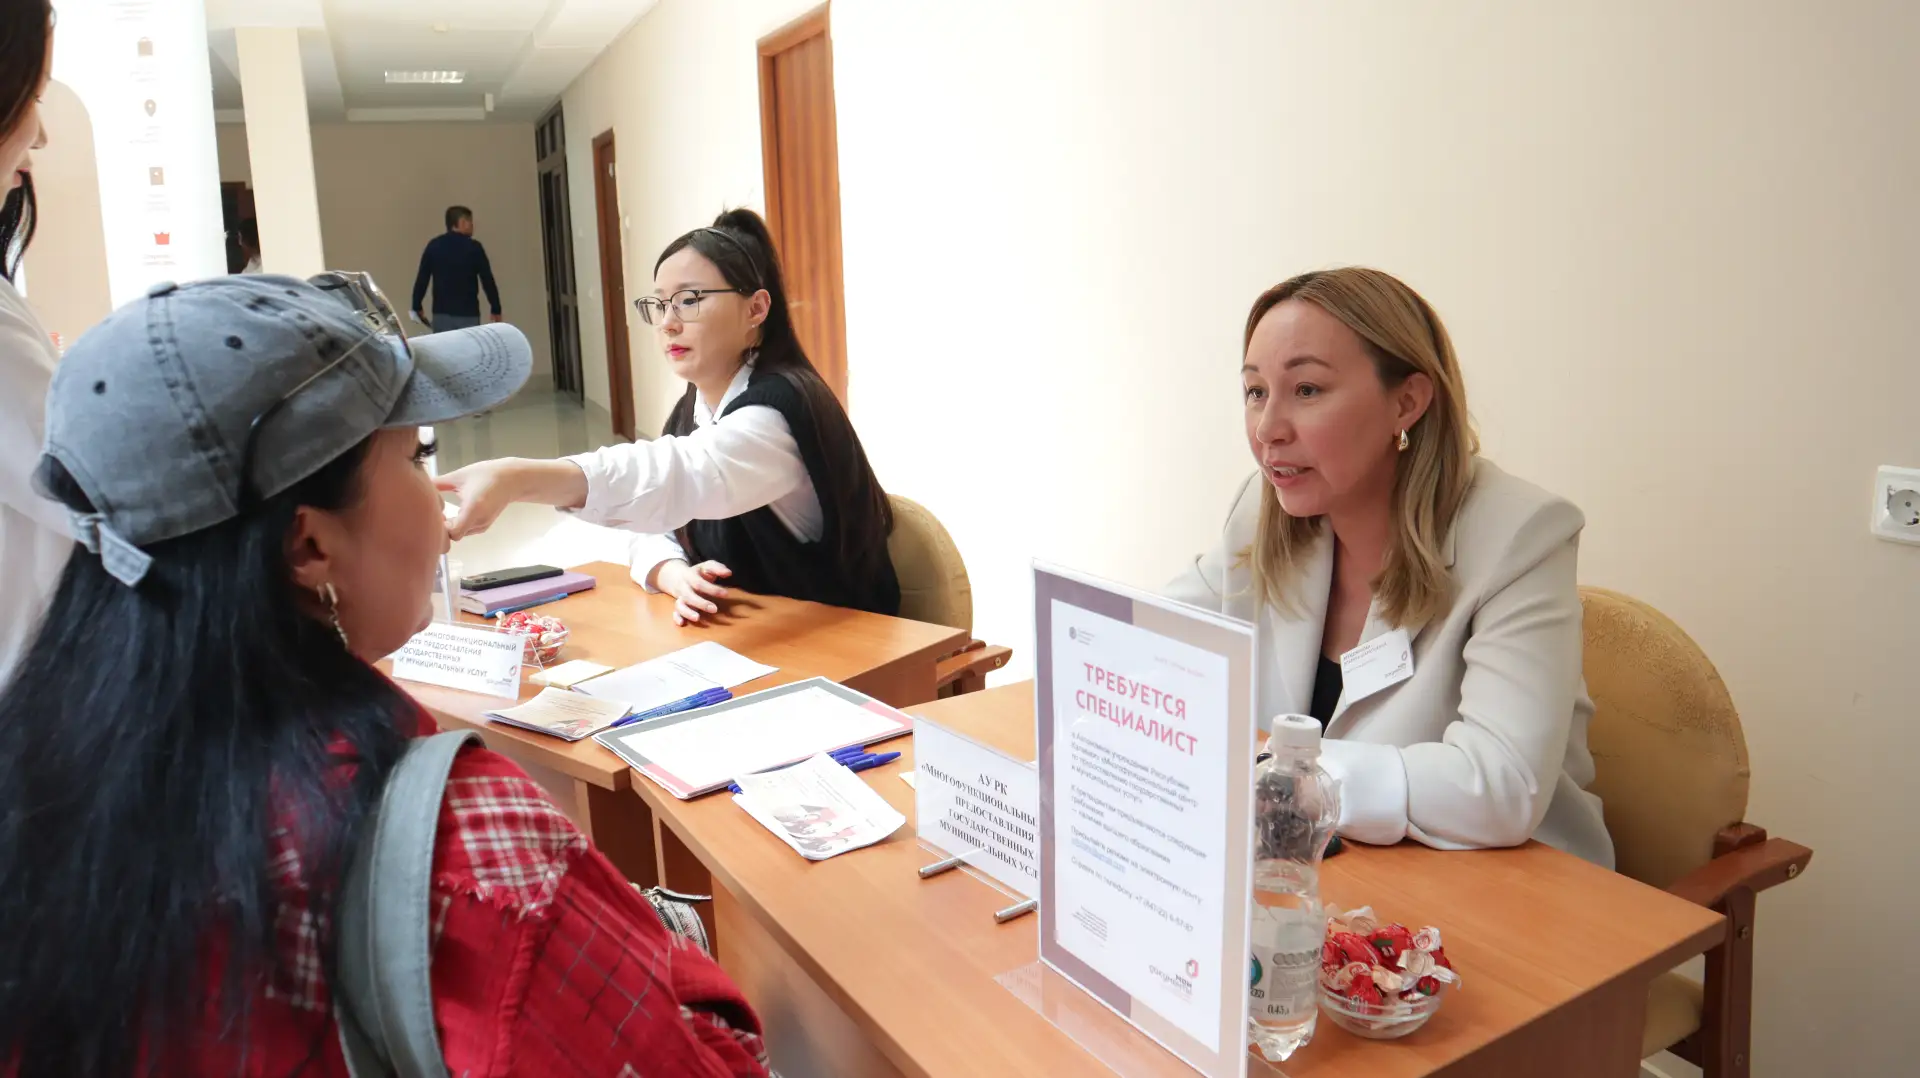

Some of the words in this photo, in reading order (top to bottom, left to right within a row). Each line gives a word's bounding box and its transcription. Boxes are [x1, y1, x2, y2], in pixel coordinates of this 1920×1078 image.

[401, 647, 461, 663] ГОСУДАРСТВЕННЫХ
[424, 640, 482, 656] ПРЕДОСТАВЛЕНИЯ
[406, 657, 465, 674] МУНИЦИПАЛЬНЫХ
[467, 668, 488, 678] УСЛУГ
[1084, 662, 1187, 720] ТРЕБУЕТСЯ
[1075, 690, 1199, 756] СПЕЦИАЛИСТ
[921, 762, 1037, 828] «МНОГОФУНКЦИОНАЛЬНЫ
[978, 773, 992, 787] АУ
[994, 780, 1008, 796] РК
[948, 808, 1035, 860] ГОСУДАРСТВЕННЫХ
[955, 796, 1035, 843] ПРЕДОСТАВЛЕНИЯ
[1019, 861, 1039, 880] УСЛ
